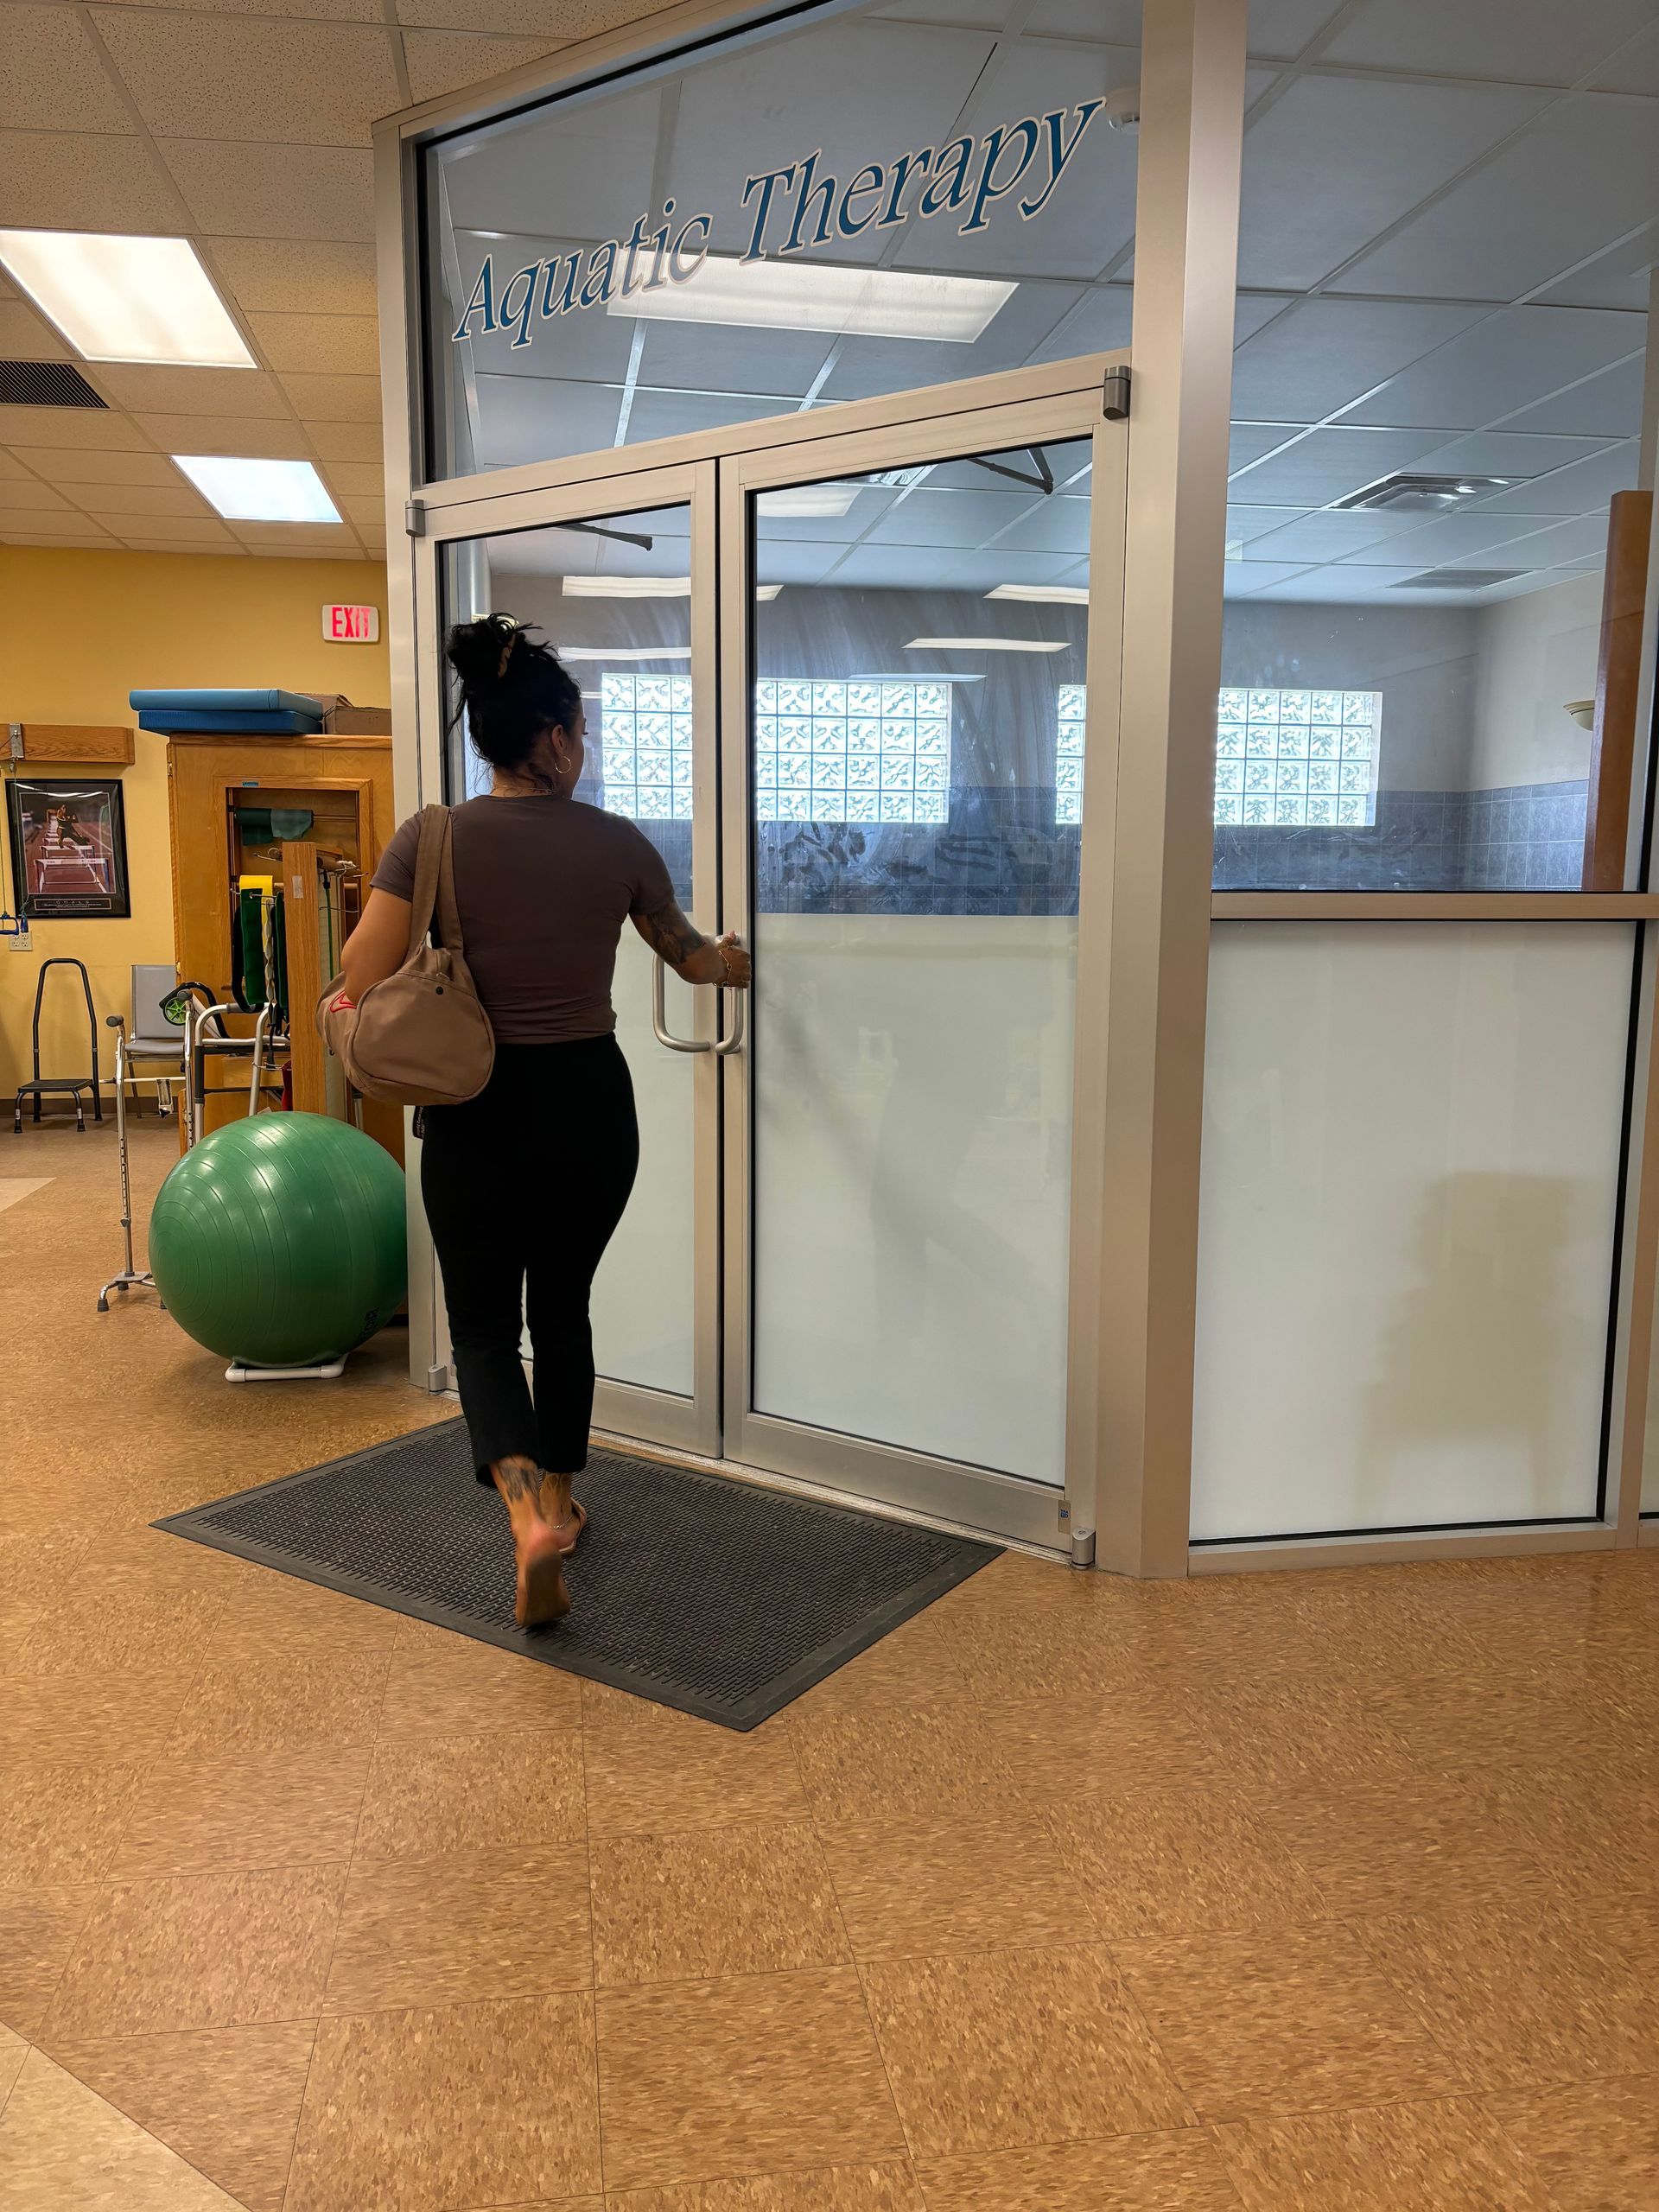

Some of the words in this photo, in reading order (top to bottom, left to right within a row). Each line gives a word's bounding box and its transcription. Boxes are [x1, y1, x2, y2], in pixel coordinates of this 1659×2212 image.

[452, 197, 713, 350] Aquatic
[740, 97, 1107, 265] Therapy
[332, 607, 371, 638] EXIT
